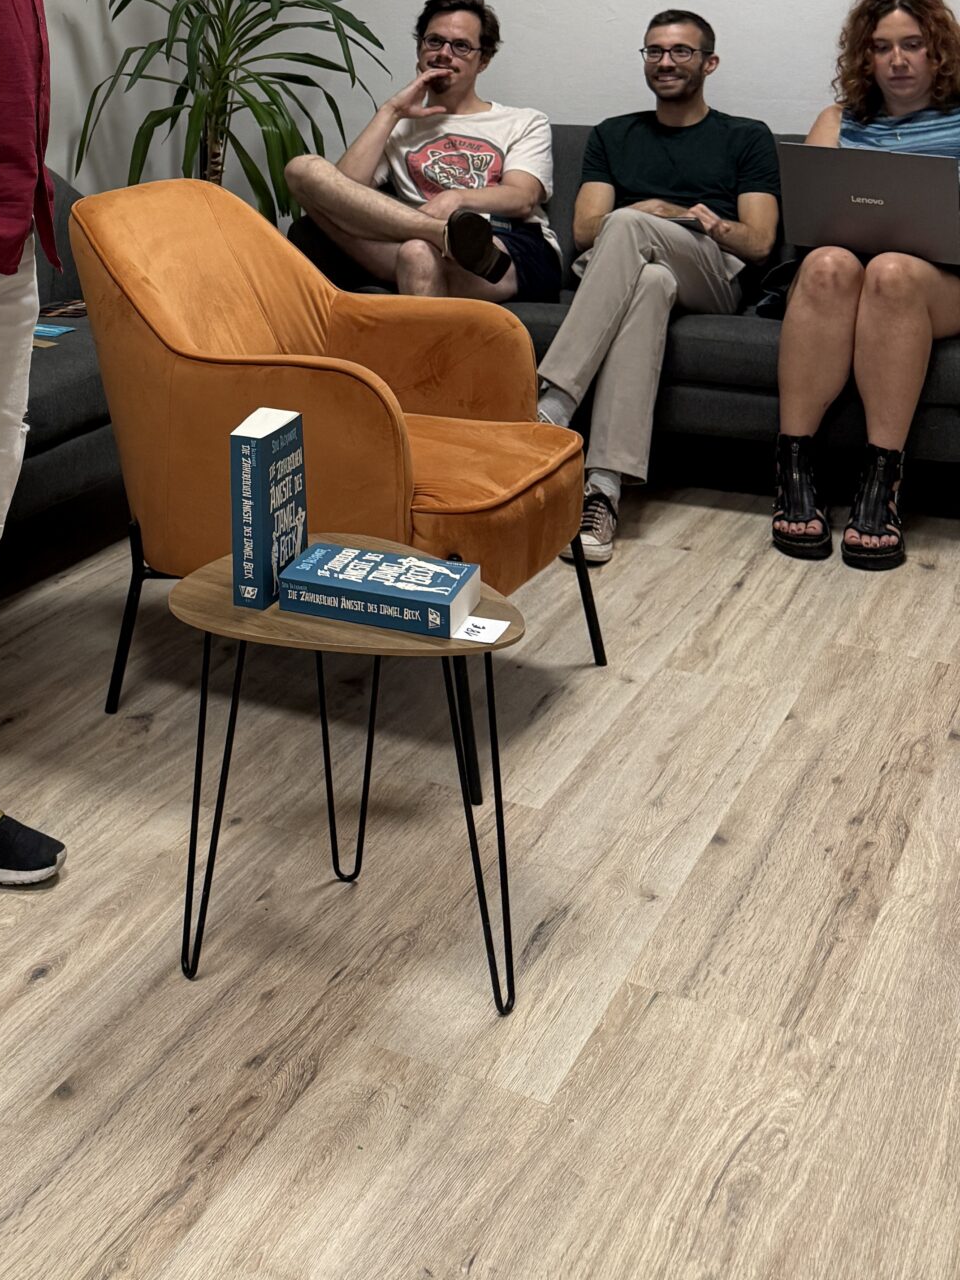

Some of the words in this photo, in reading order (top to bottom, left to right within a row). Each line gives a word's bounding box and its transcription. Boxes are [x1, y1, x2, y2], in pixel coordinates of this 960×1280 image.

[851, 195, 885, 206] Lenovo
[287, 589, 298, 600] DIE
[299, 591, 339, 608] ZAHLREICHEN
[340, 595, 365, 612] ÄNGSTE
[367, 603, 378, 614] DES
[379, 603, 402, 618] DANIEL
[403, 607, 422, 622] BECK
